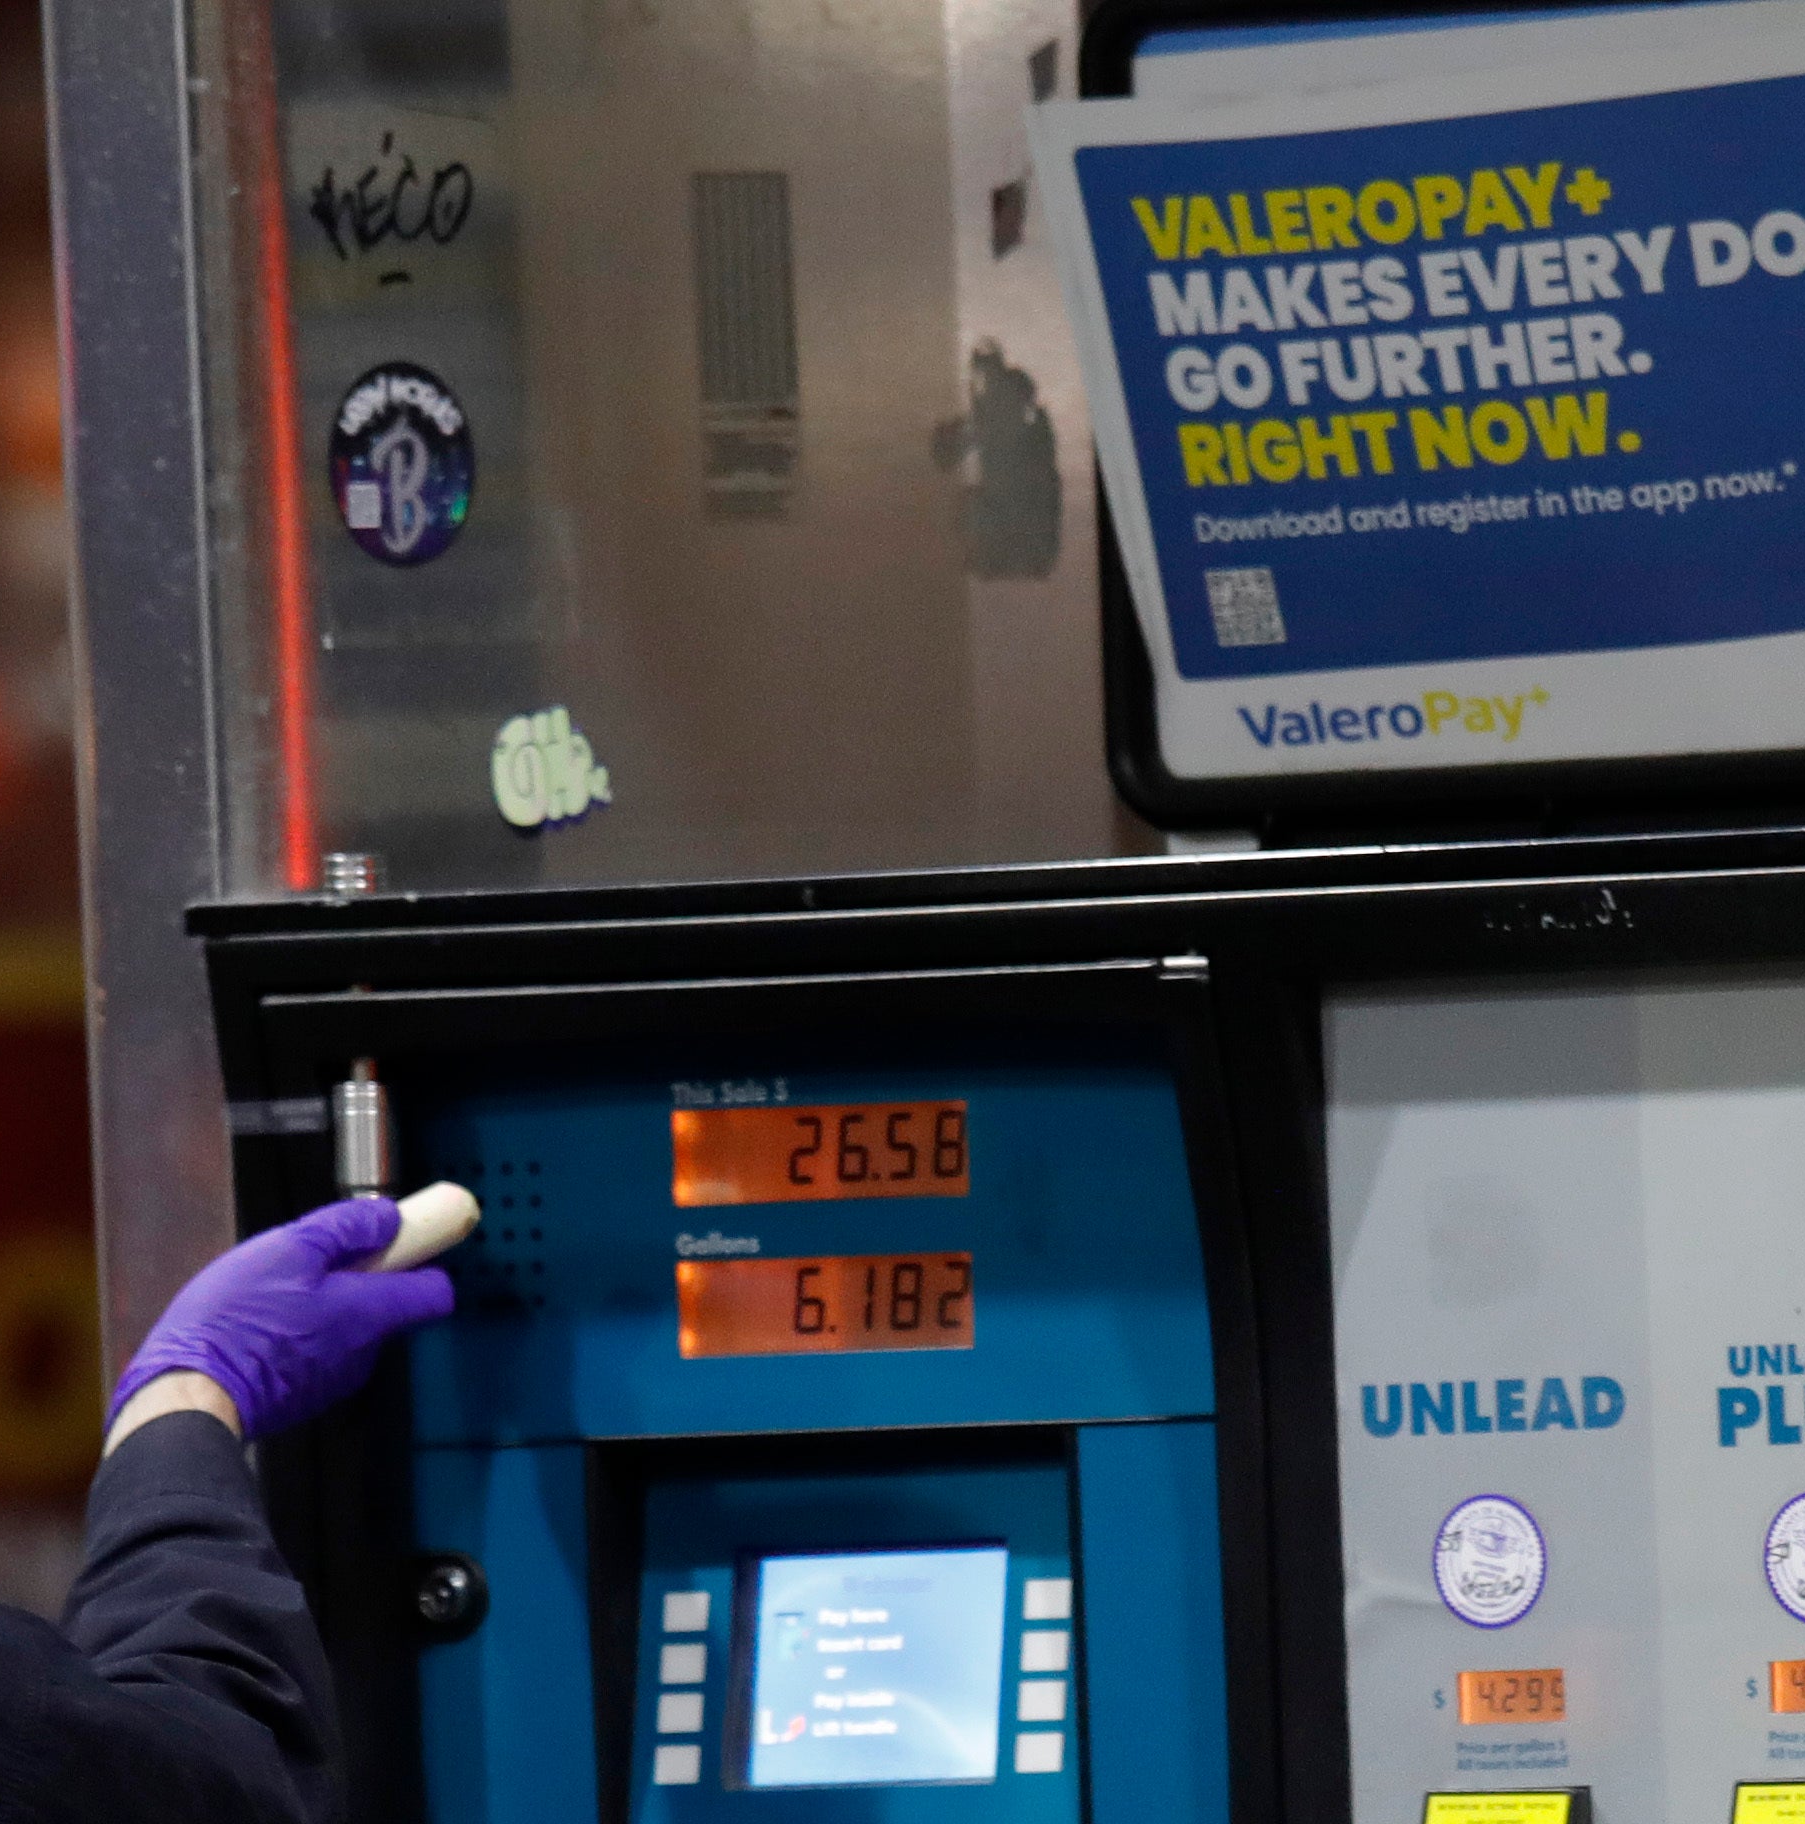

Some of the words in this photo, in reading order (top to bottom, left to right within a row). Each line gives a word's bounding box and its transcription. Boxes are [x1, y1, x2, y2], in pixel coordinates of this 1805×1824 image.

[1131, 162, 1612, 261] VALEROPAY+
[1148, 256, 1415, 337] MAKES
[1420, 226, 1674, 318] EVERY
[1165, 344, 1273, 412] GO
[1279, 312, 1654, 406] FURTHER.
[1177, 411, 1399, 488] RIGHT
[1407, 392, 1643, 471] NOW.
[1195, 504, 1343, 543] Download
[1349, 497, 1412, 534] and
[1417, 489, 1531, 534] register
[1537, 487, 1568, 518] in
[1572, 481, 1626, 515] the
[1629, 479, 1698, 515] app
[788, 1109, 967, 1186] 26.58
[675, 1231, 761, 1257] Gallons
[794, 1260, 970, 1335] 6.182
[1360, 1375, 1628, 1439] UNLEAD
[1432, 1687, 1447, 1710] $
[1745, 1677, 1759, 1700] $
